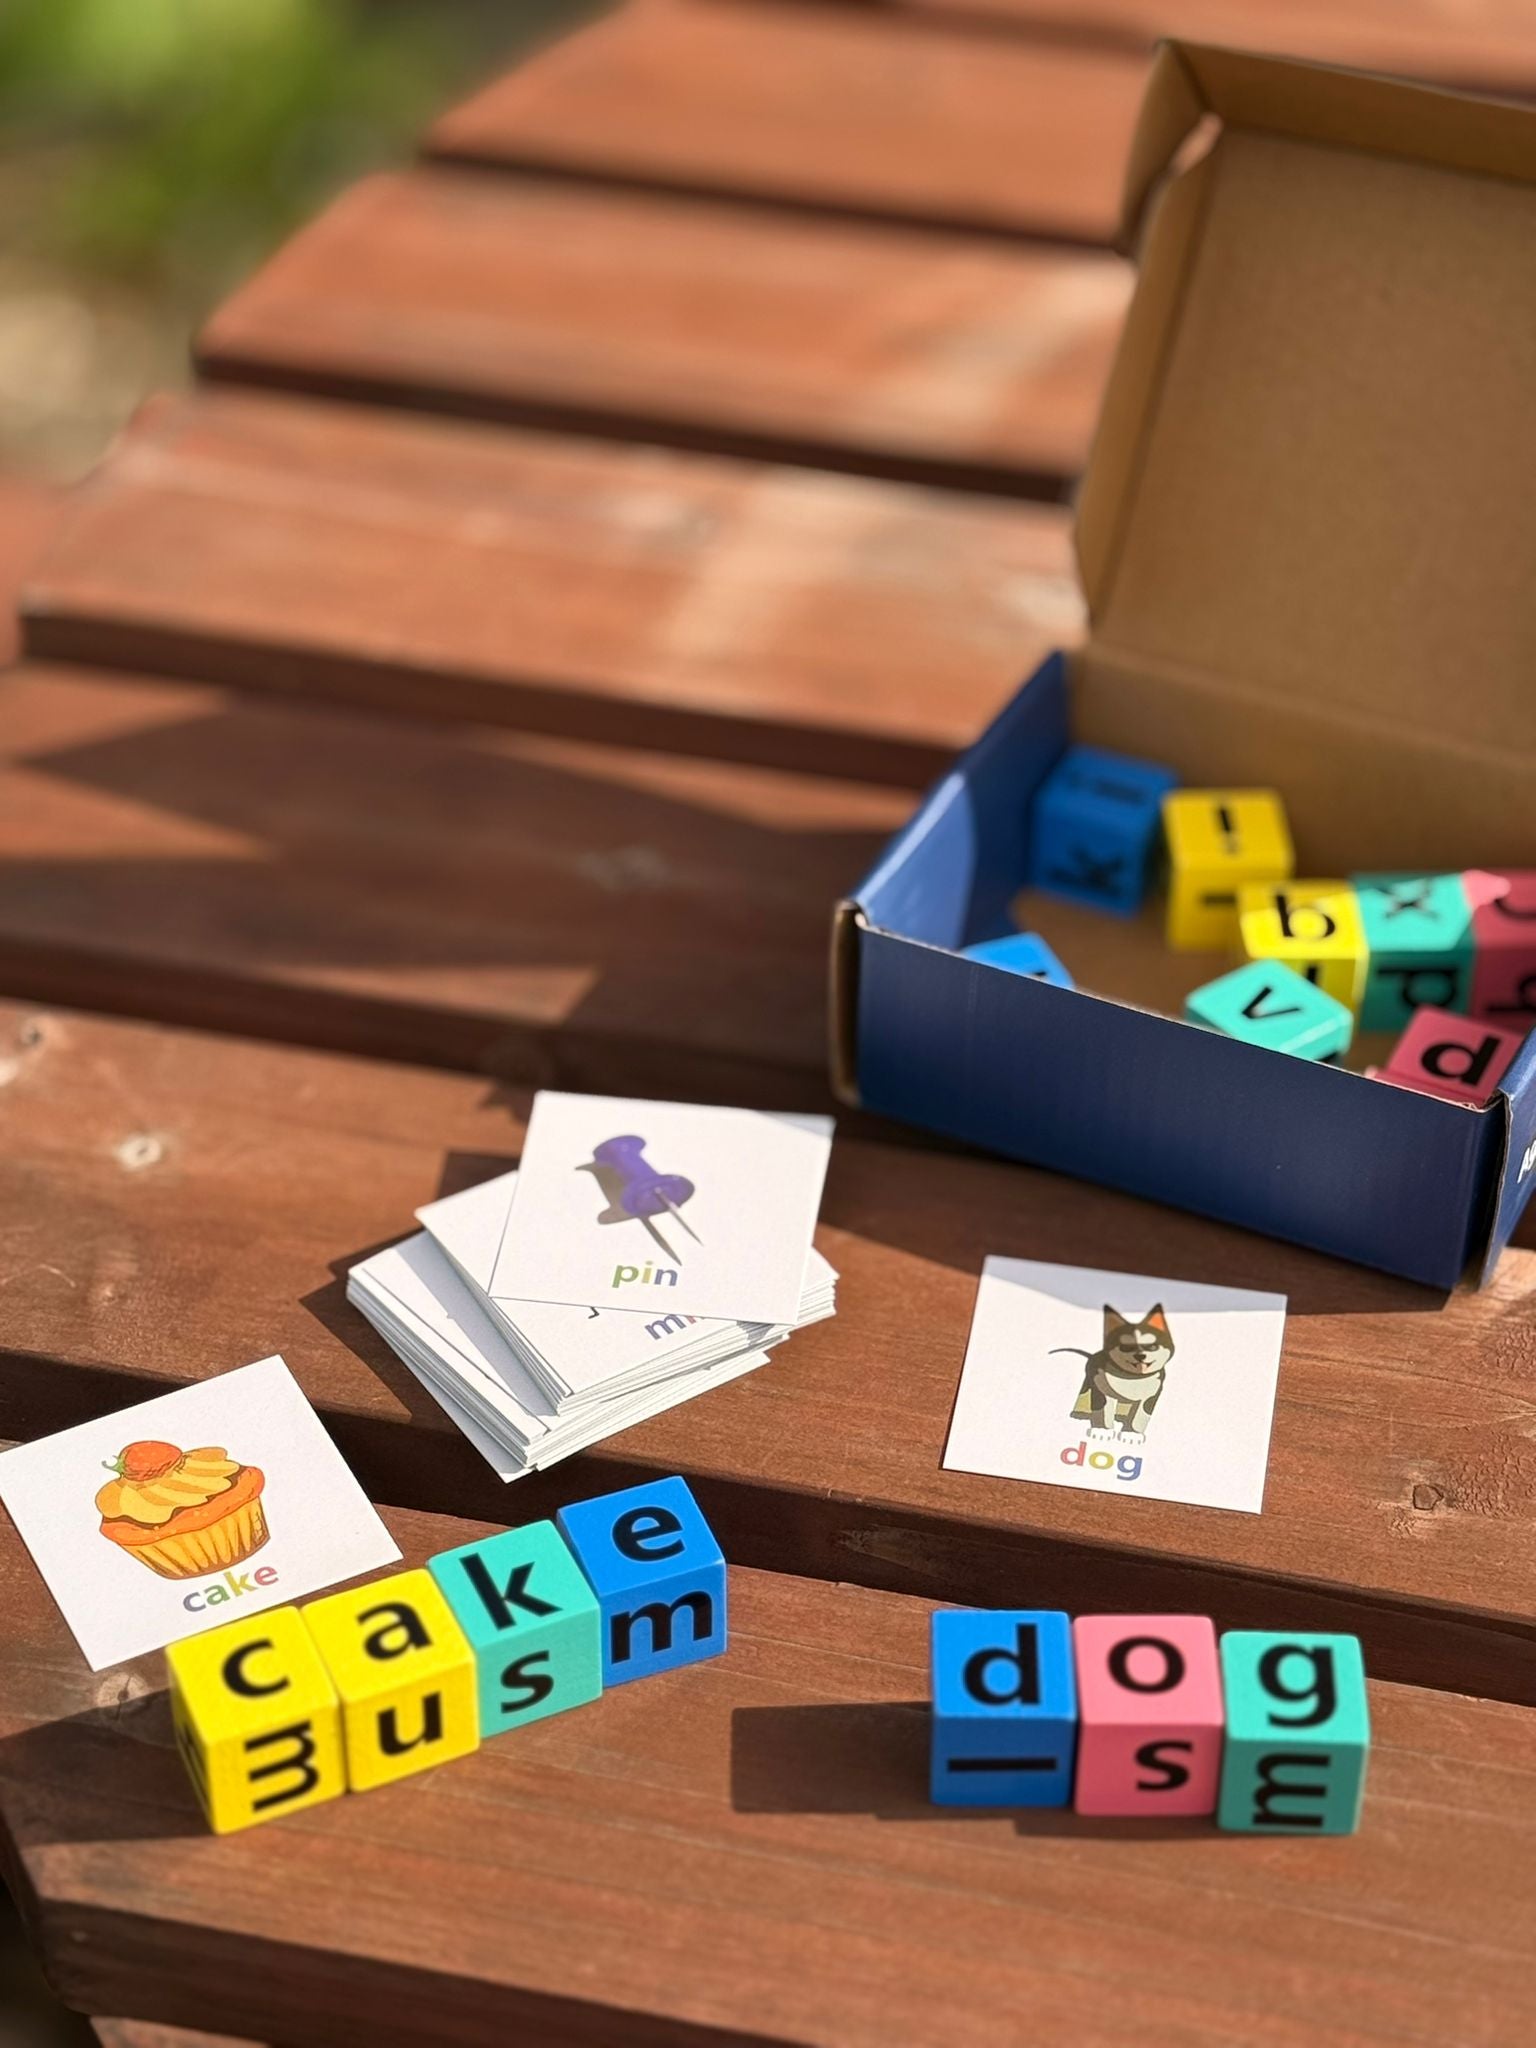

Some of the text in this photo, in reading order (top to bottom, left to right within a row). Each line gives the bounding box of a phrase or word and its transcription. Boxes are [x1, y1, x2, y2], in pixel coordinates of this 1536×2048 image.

[1275, 893, 1336, 938] b
[1421, 1036, 1500, 1085] d
[612, 1260, 678, 1289] pin
[1060, 1441, 1143, 1481] dog
[183, 1566, 279, 1612] cake
[610, 1589, 713, 1665] m
